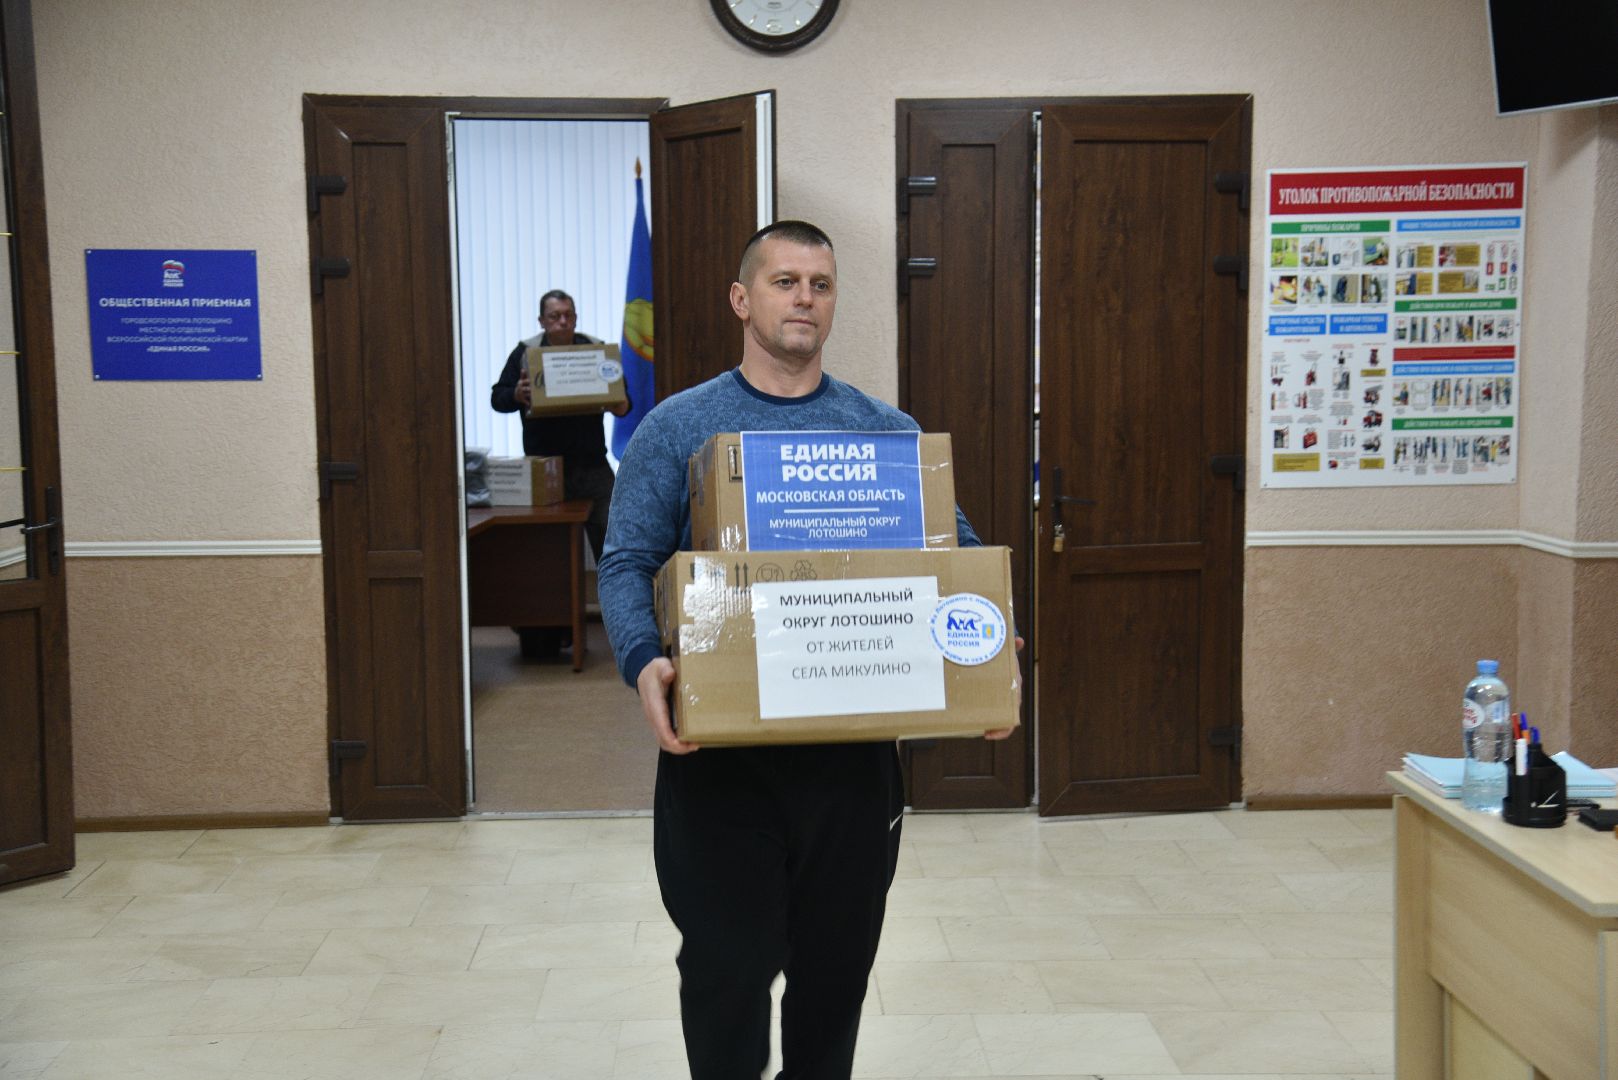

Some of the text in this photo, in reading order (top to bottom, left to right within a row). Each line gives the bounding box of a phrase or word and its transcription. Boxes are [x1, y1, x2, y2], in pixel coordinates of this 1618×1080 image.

[1279, 180, 1514, 205] УГОЛОК ПРОТИВОПОЖАРНОЙ БЕЗОПАСНОСТИ
[99, 297, 251, 308] ОБЩЕСТВЕННАЯ ПРИЕМНАЯ
[780, 443, 876, 463] ЕДИНАЯ
[782, 464, 877, 482] РОССИЯ
[756, 488, 906, 504] МОСКОВСКАЯ ОБЛАСТЬ
[769, 516, 901, 530] МУНИЦИПАЛЬНЫЙ ОКРУГ
[808, 527, 867, 539] ЛОТОШИНО
[780, 588, 913, 607] МУНИЦИПАЛЬНЫЙ
[783, 613, 914, 629] ОКРУГ ЛОТОШИНО
[806, 634, 894, 653] ОТ ЖИТЕЛЕЙ
[792, 662, 911, 680] СЕЛА МИКУЛИНО
